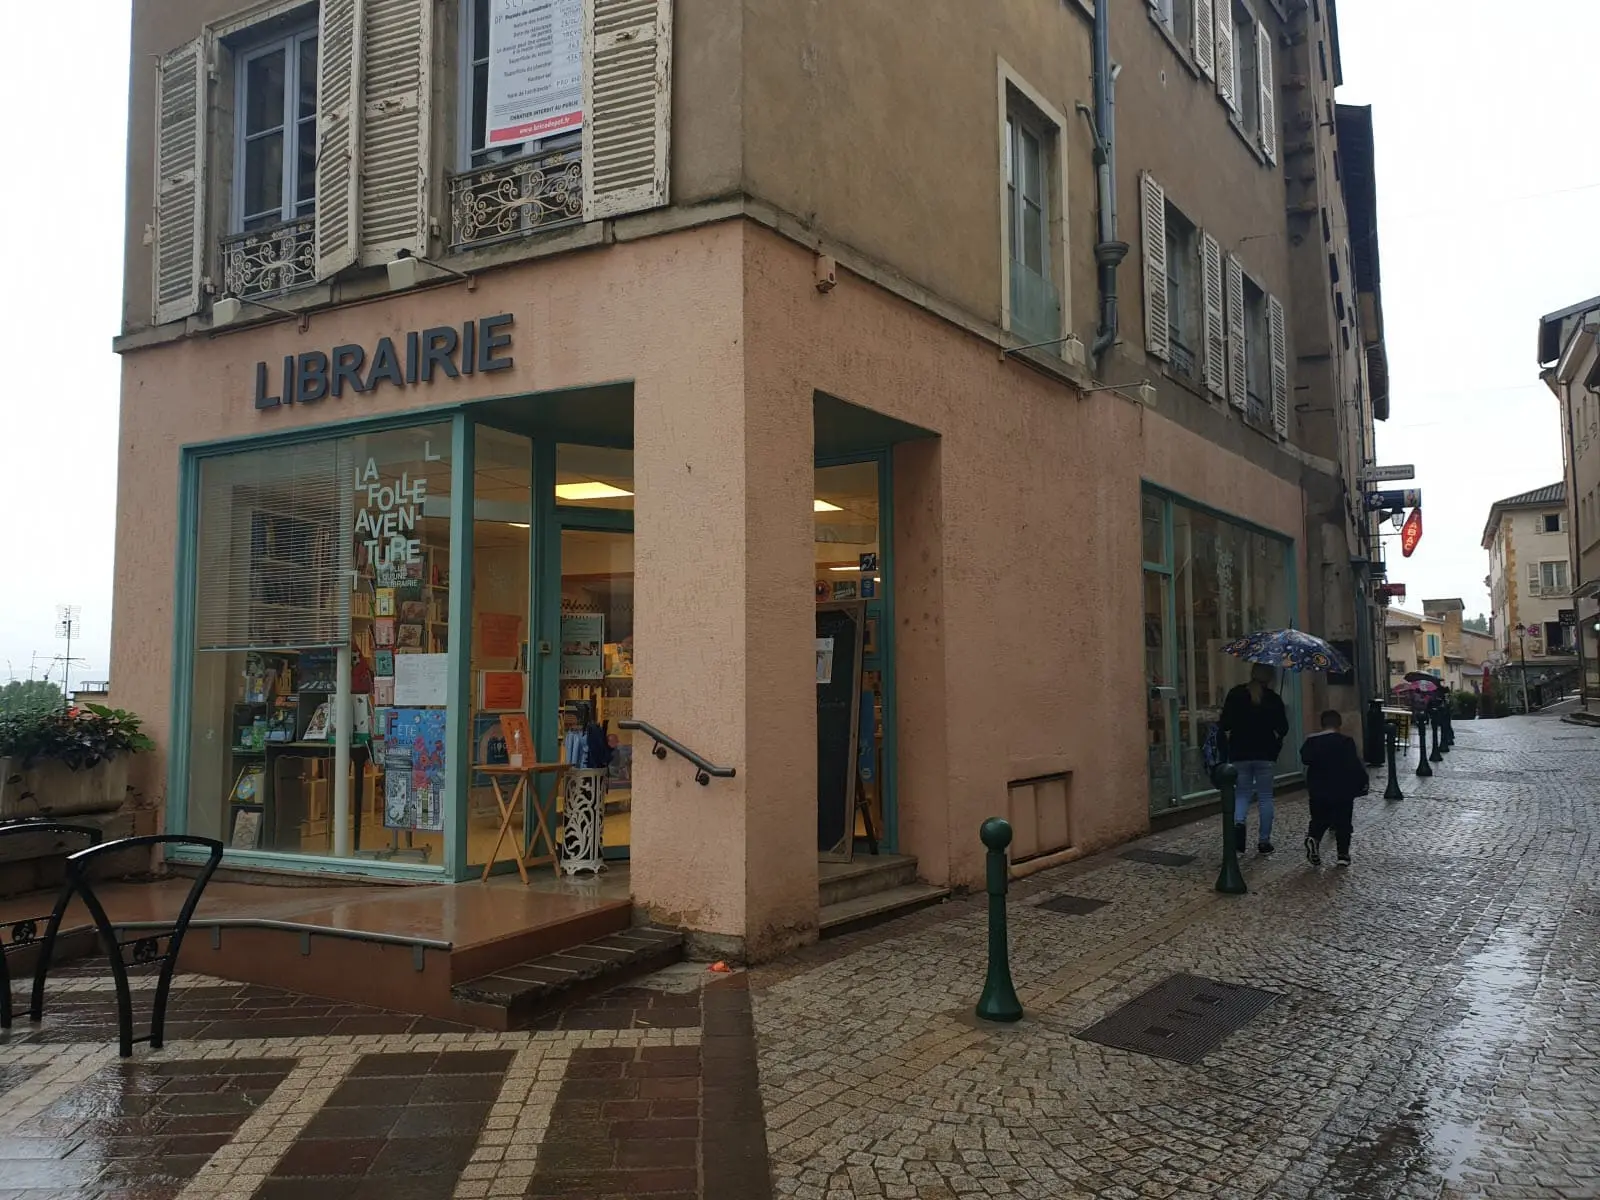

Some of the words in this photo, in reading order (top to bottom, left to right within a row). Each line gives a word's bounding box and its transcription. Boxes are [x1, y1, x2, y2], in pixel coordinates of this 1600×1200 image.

[255, 313, 513, 409] LIBRAIRIE
[354, 457, 379, 490] LA
[367, 471, 428, 512] FOLLE
[363, 533, 421, 567] TURE
[1404, 512, 1419, 552] TABAC
